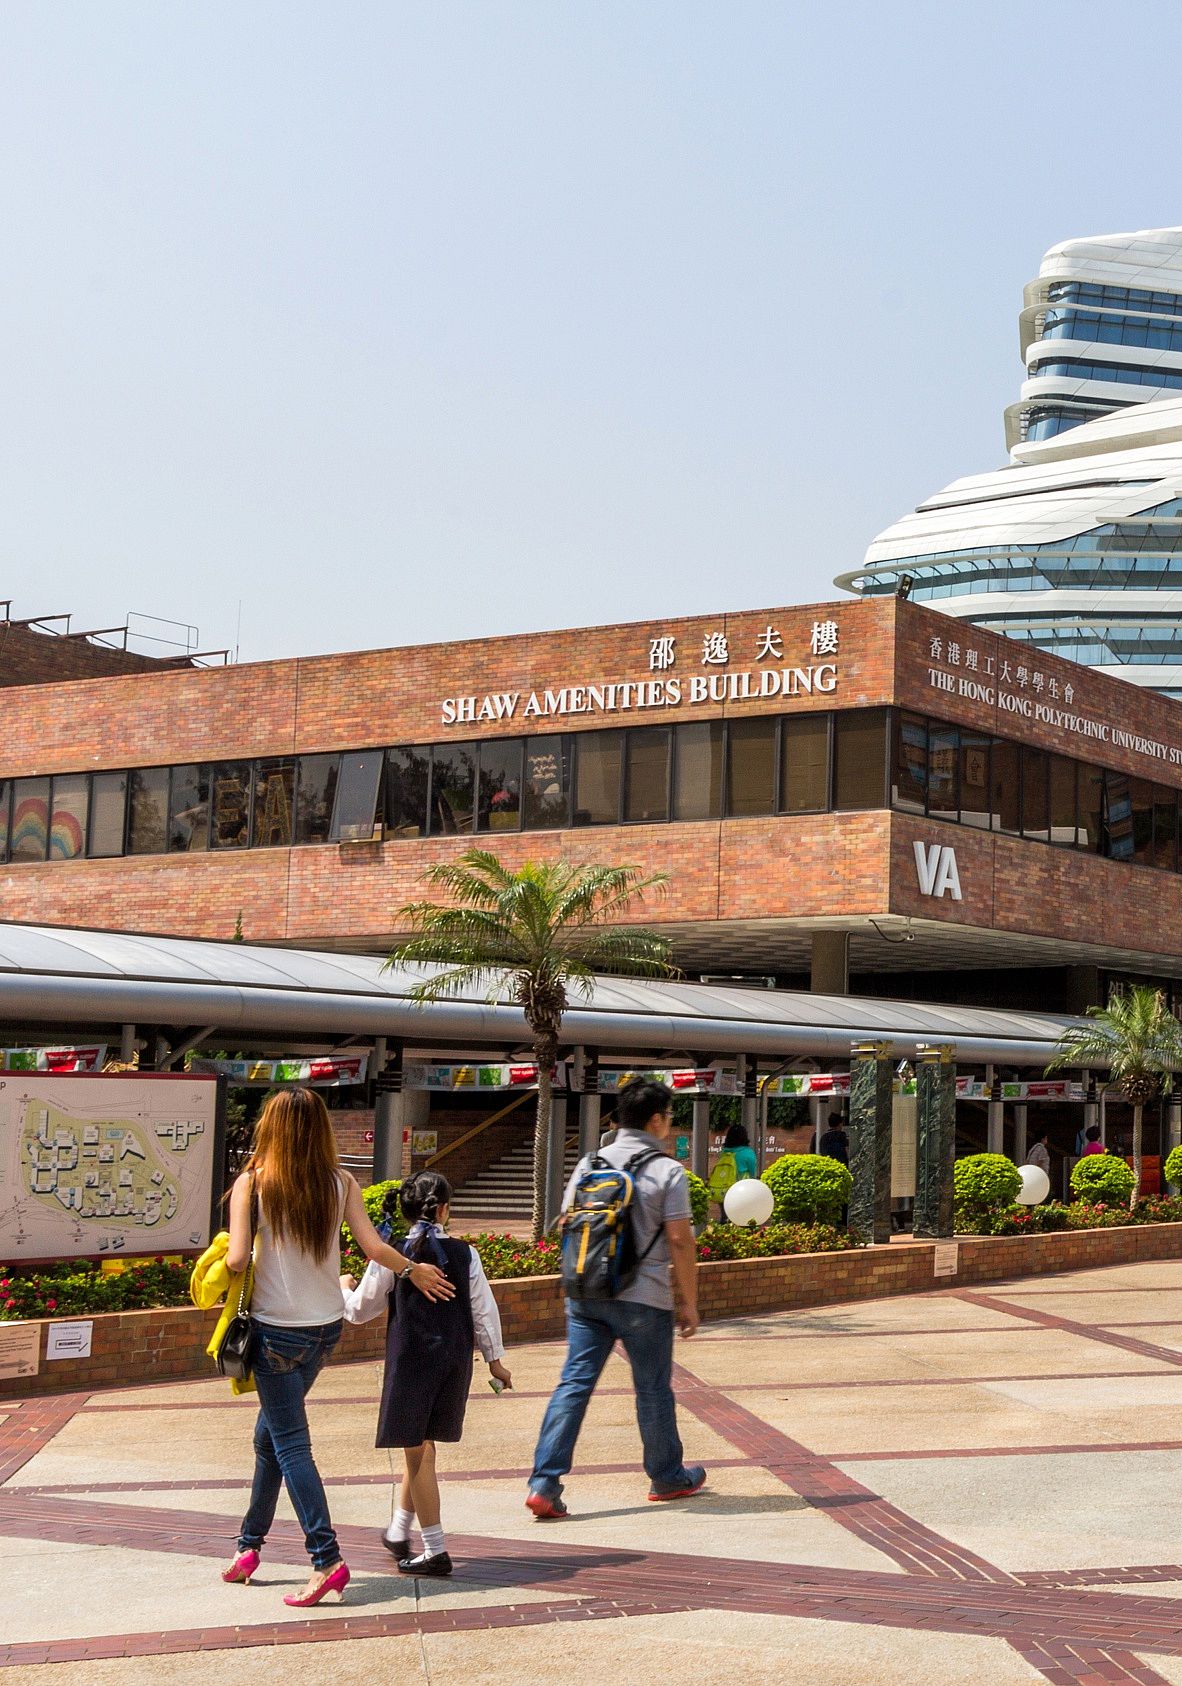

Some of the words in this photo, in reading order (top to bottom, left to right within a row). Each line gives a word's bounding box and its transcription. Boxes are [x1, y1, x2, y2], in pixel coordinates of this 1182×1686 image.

[648, 620, 839, 670] 邵逸夫樓
[929, 636, 1075, 705] 香港理工大學學生會
[441, 691, 520, 724] SHAW
[523, 678, 682, 717] AMENITIES
[689, 664, 838, 703] BUILDING
[928, 668, 956, 693] THE
[958, 678, 995, 706] HONG
[997, 690, 1032, 718] KONG
[1034, 703, 1109, 742] POLYTECHNIC
[1111, 728, 1168, 760] UNIVERSITY
[913, 841, 963, 901] VA
